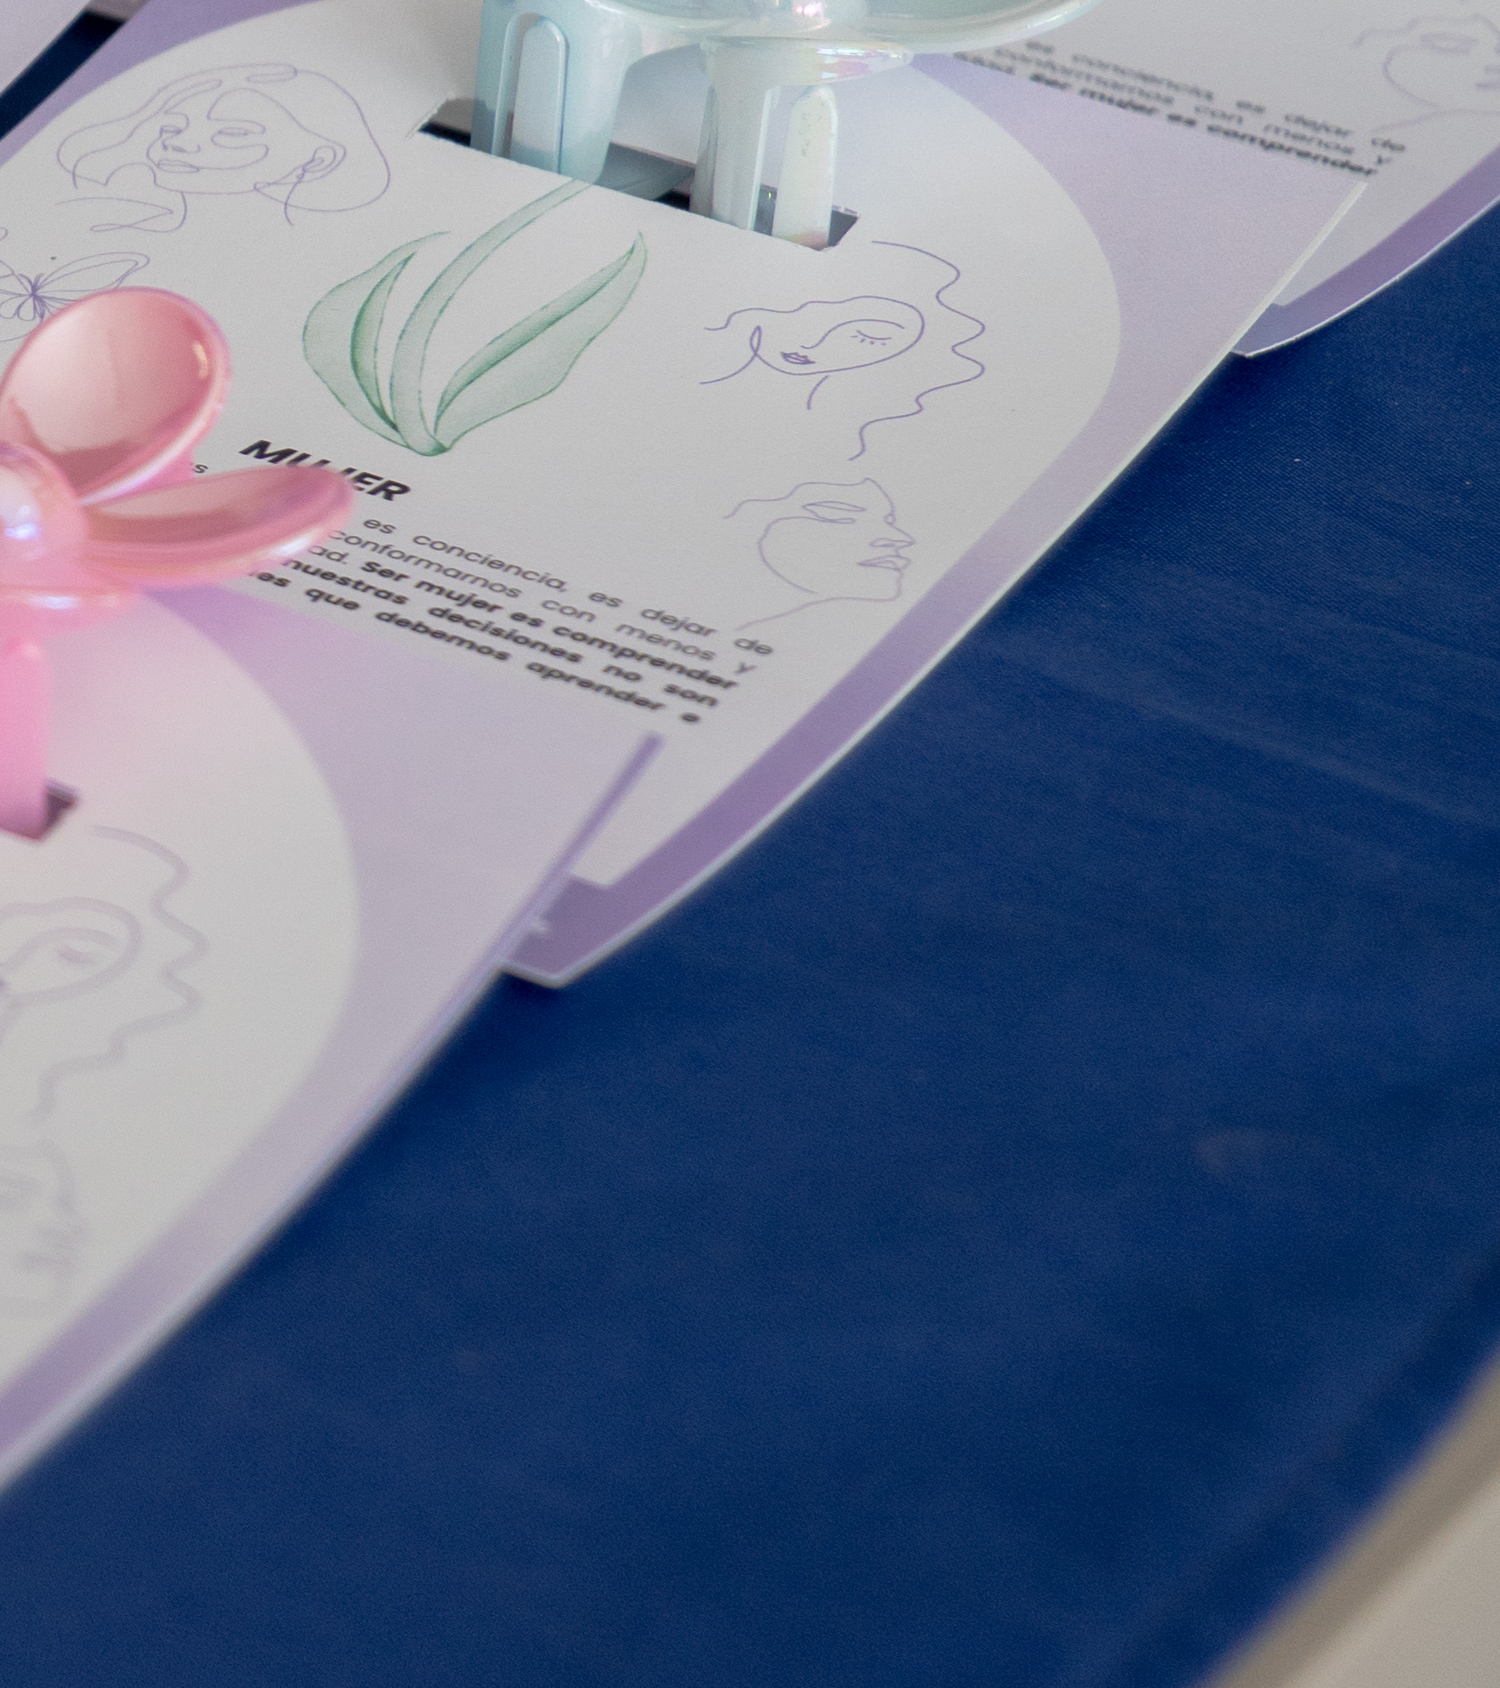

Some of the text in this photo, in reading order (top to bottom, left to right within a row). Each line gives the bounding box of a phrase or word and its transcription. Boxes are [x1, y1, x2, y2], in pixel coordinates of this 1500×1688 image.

[359, 561, 738, 689] Ser mujer es comprender
[362, 518, 775, 657] es conciencia, es dejar de
